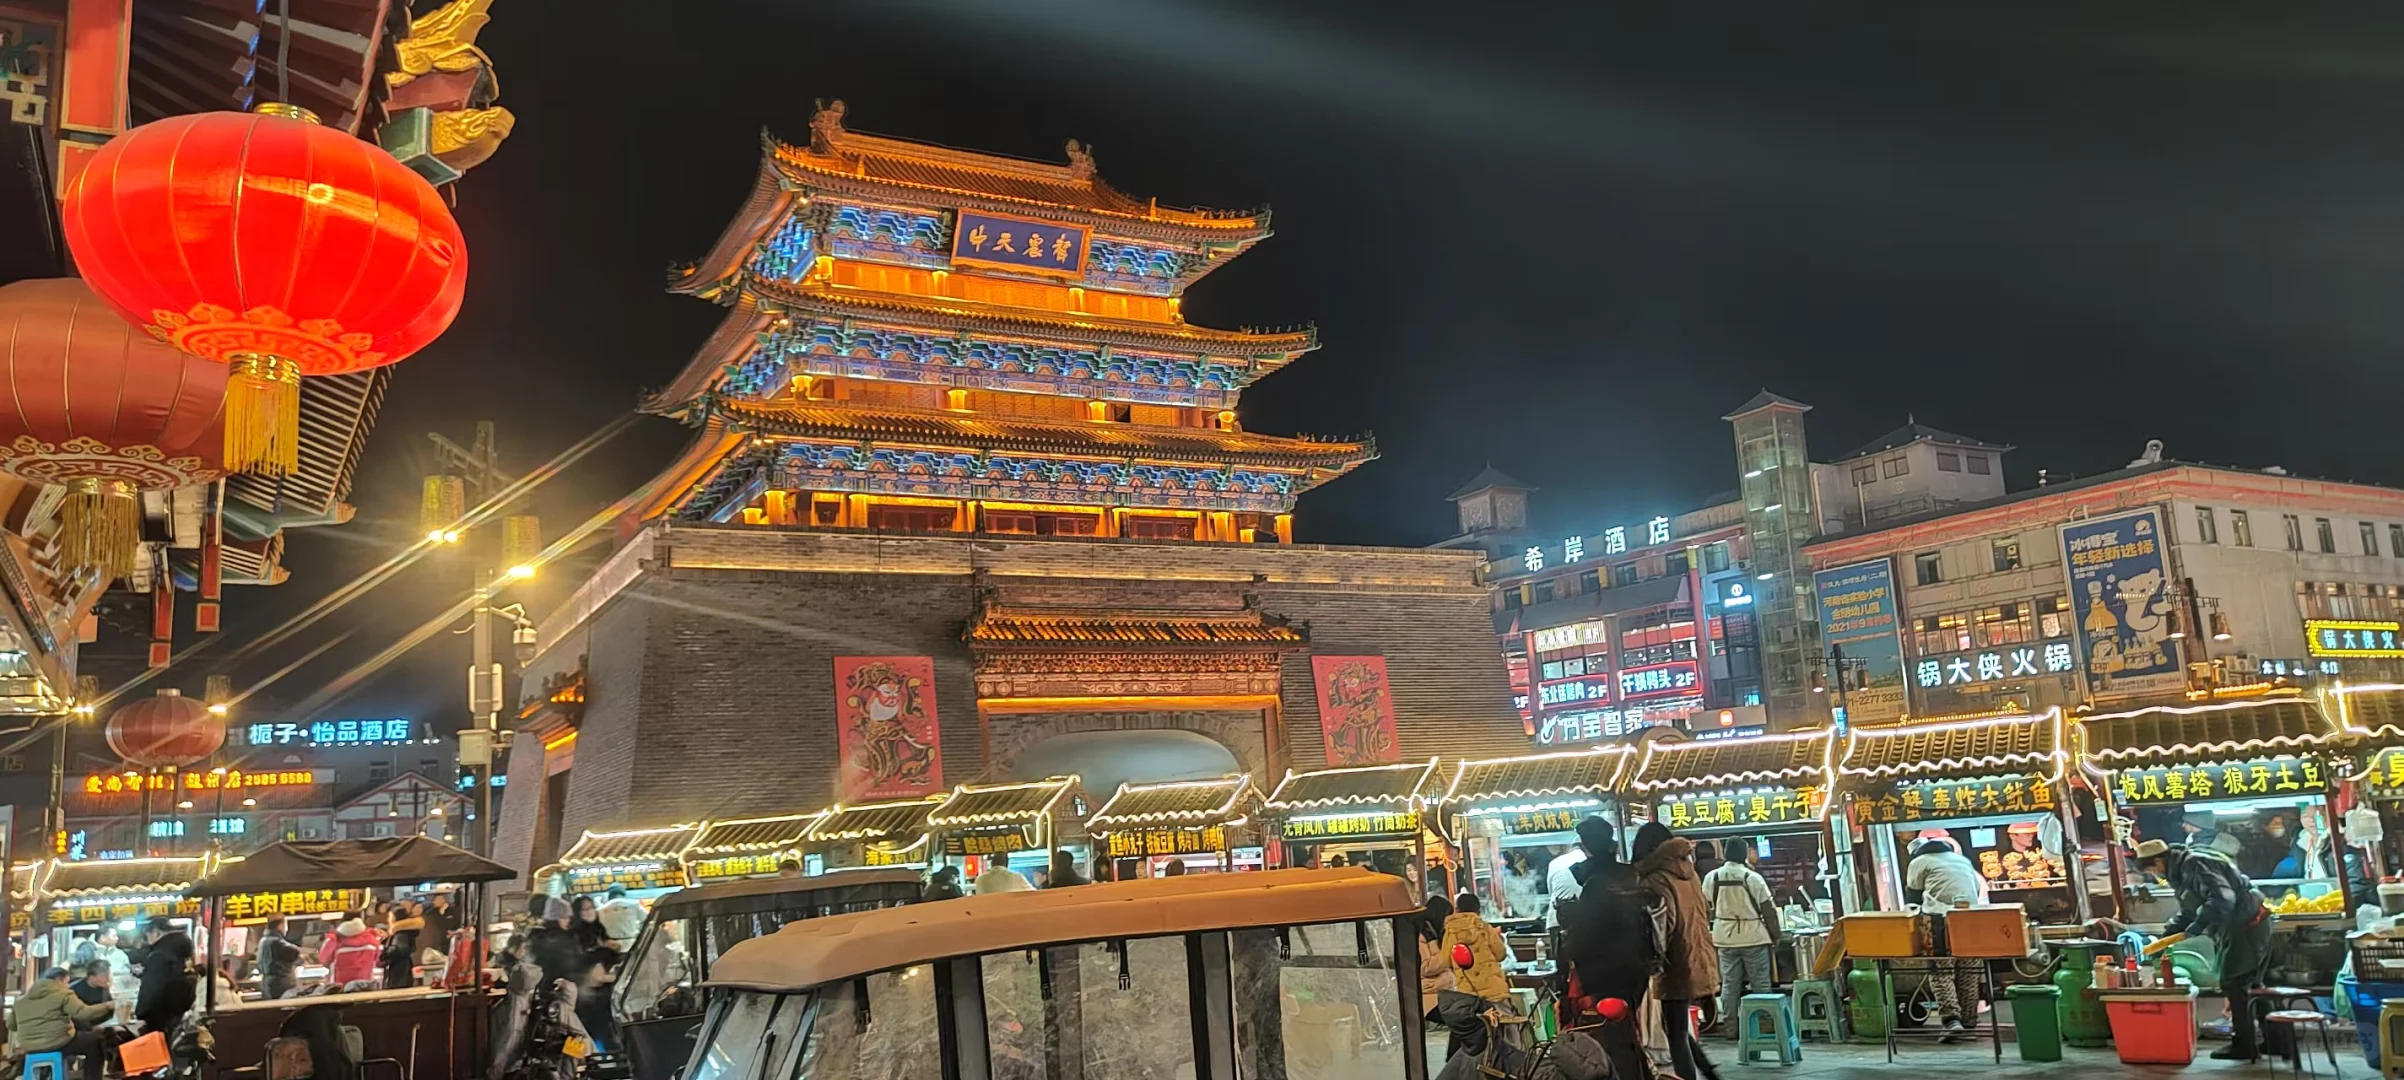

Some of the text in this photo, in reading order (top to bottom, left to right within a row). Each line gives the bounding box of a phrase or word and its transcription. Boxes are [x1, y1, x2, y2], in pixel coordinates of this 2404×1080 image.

[1524, 515, 1670, 572] 希岸酒店
[2072, 540, 2155, 566] 年轻新选择
[1675, 672, 1695, 688] 2F
[1917, 643, 2073, 688] 锅大侠火锅
[1587, 684, 1608, 699] 2F
[2119, 762, 2325, 800] 旋风薯塔 狼牙土豆
[1671, 798, 1736, 828] 臭豆腐
[1749, 791, 1811, 823] 臭干子
[1855, 779, 2055, 823] 黄金蟹 轰炸大鱿鱼
[225, 892, 305, 918] 羊肉串
